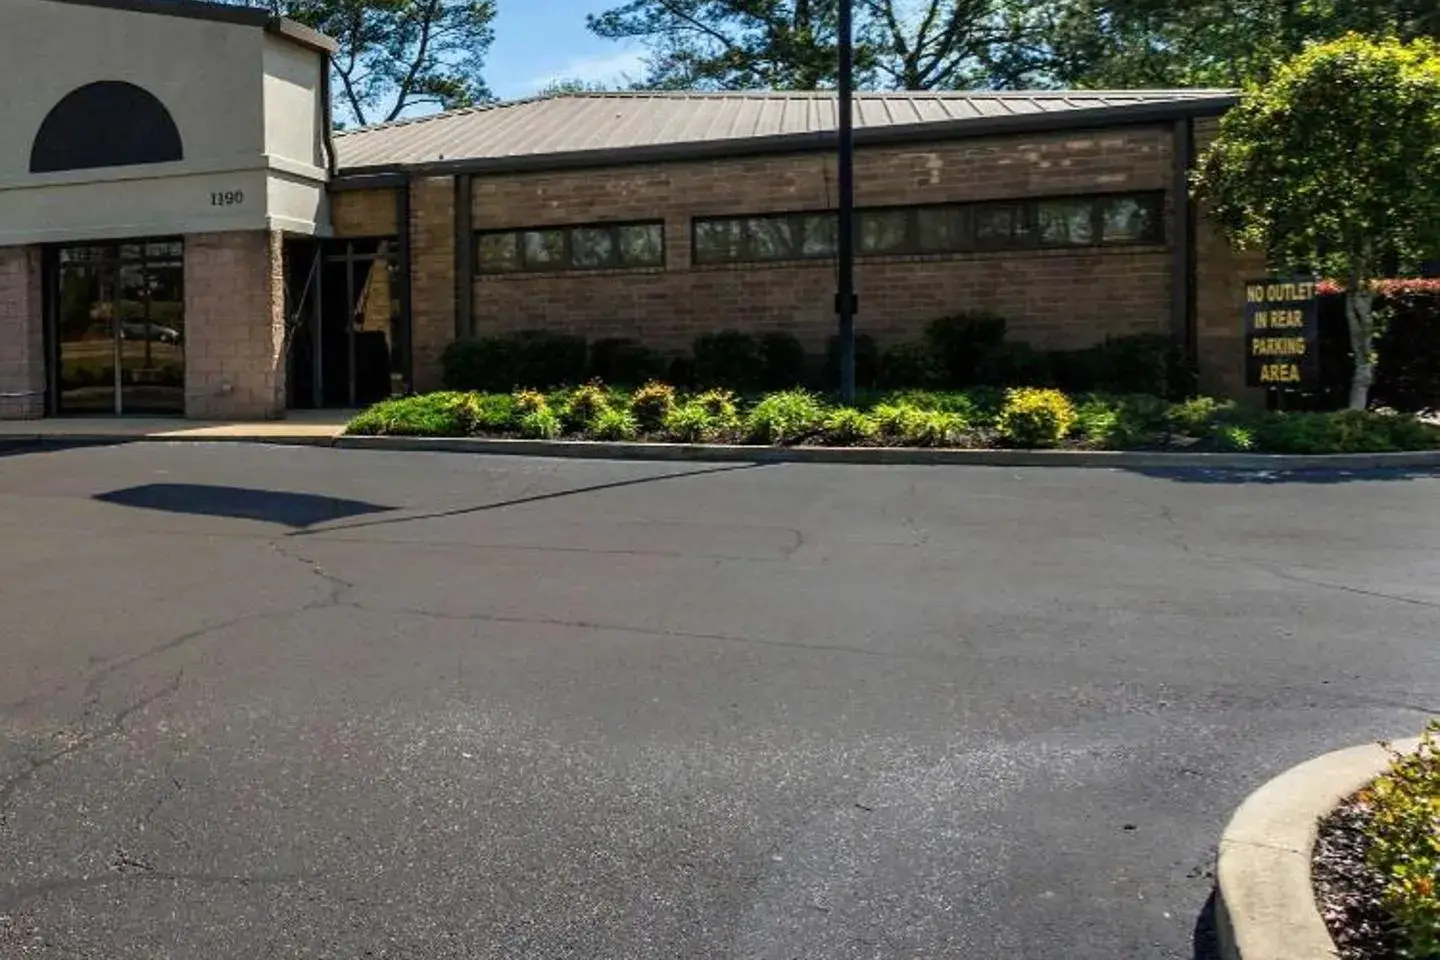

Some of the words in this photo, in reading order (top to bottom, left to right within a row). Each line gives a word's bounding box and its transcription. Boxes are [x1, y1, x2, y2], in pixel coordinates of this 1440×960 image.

[1247, 285, 1264, 302] NO
[1266, 282, 1314, 301] OUTLET
[1254, 310, 1268, 328] IN
[1270, 309, 1302, 328] REAR
[1252, 338, 1305, 355] PARKING
[1260, 364, 1300, 381] AREA
